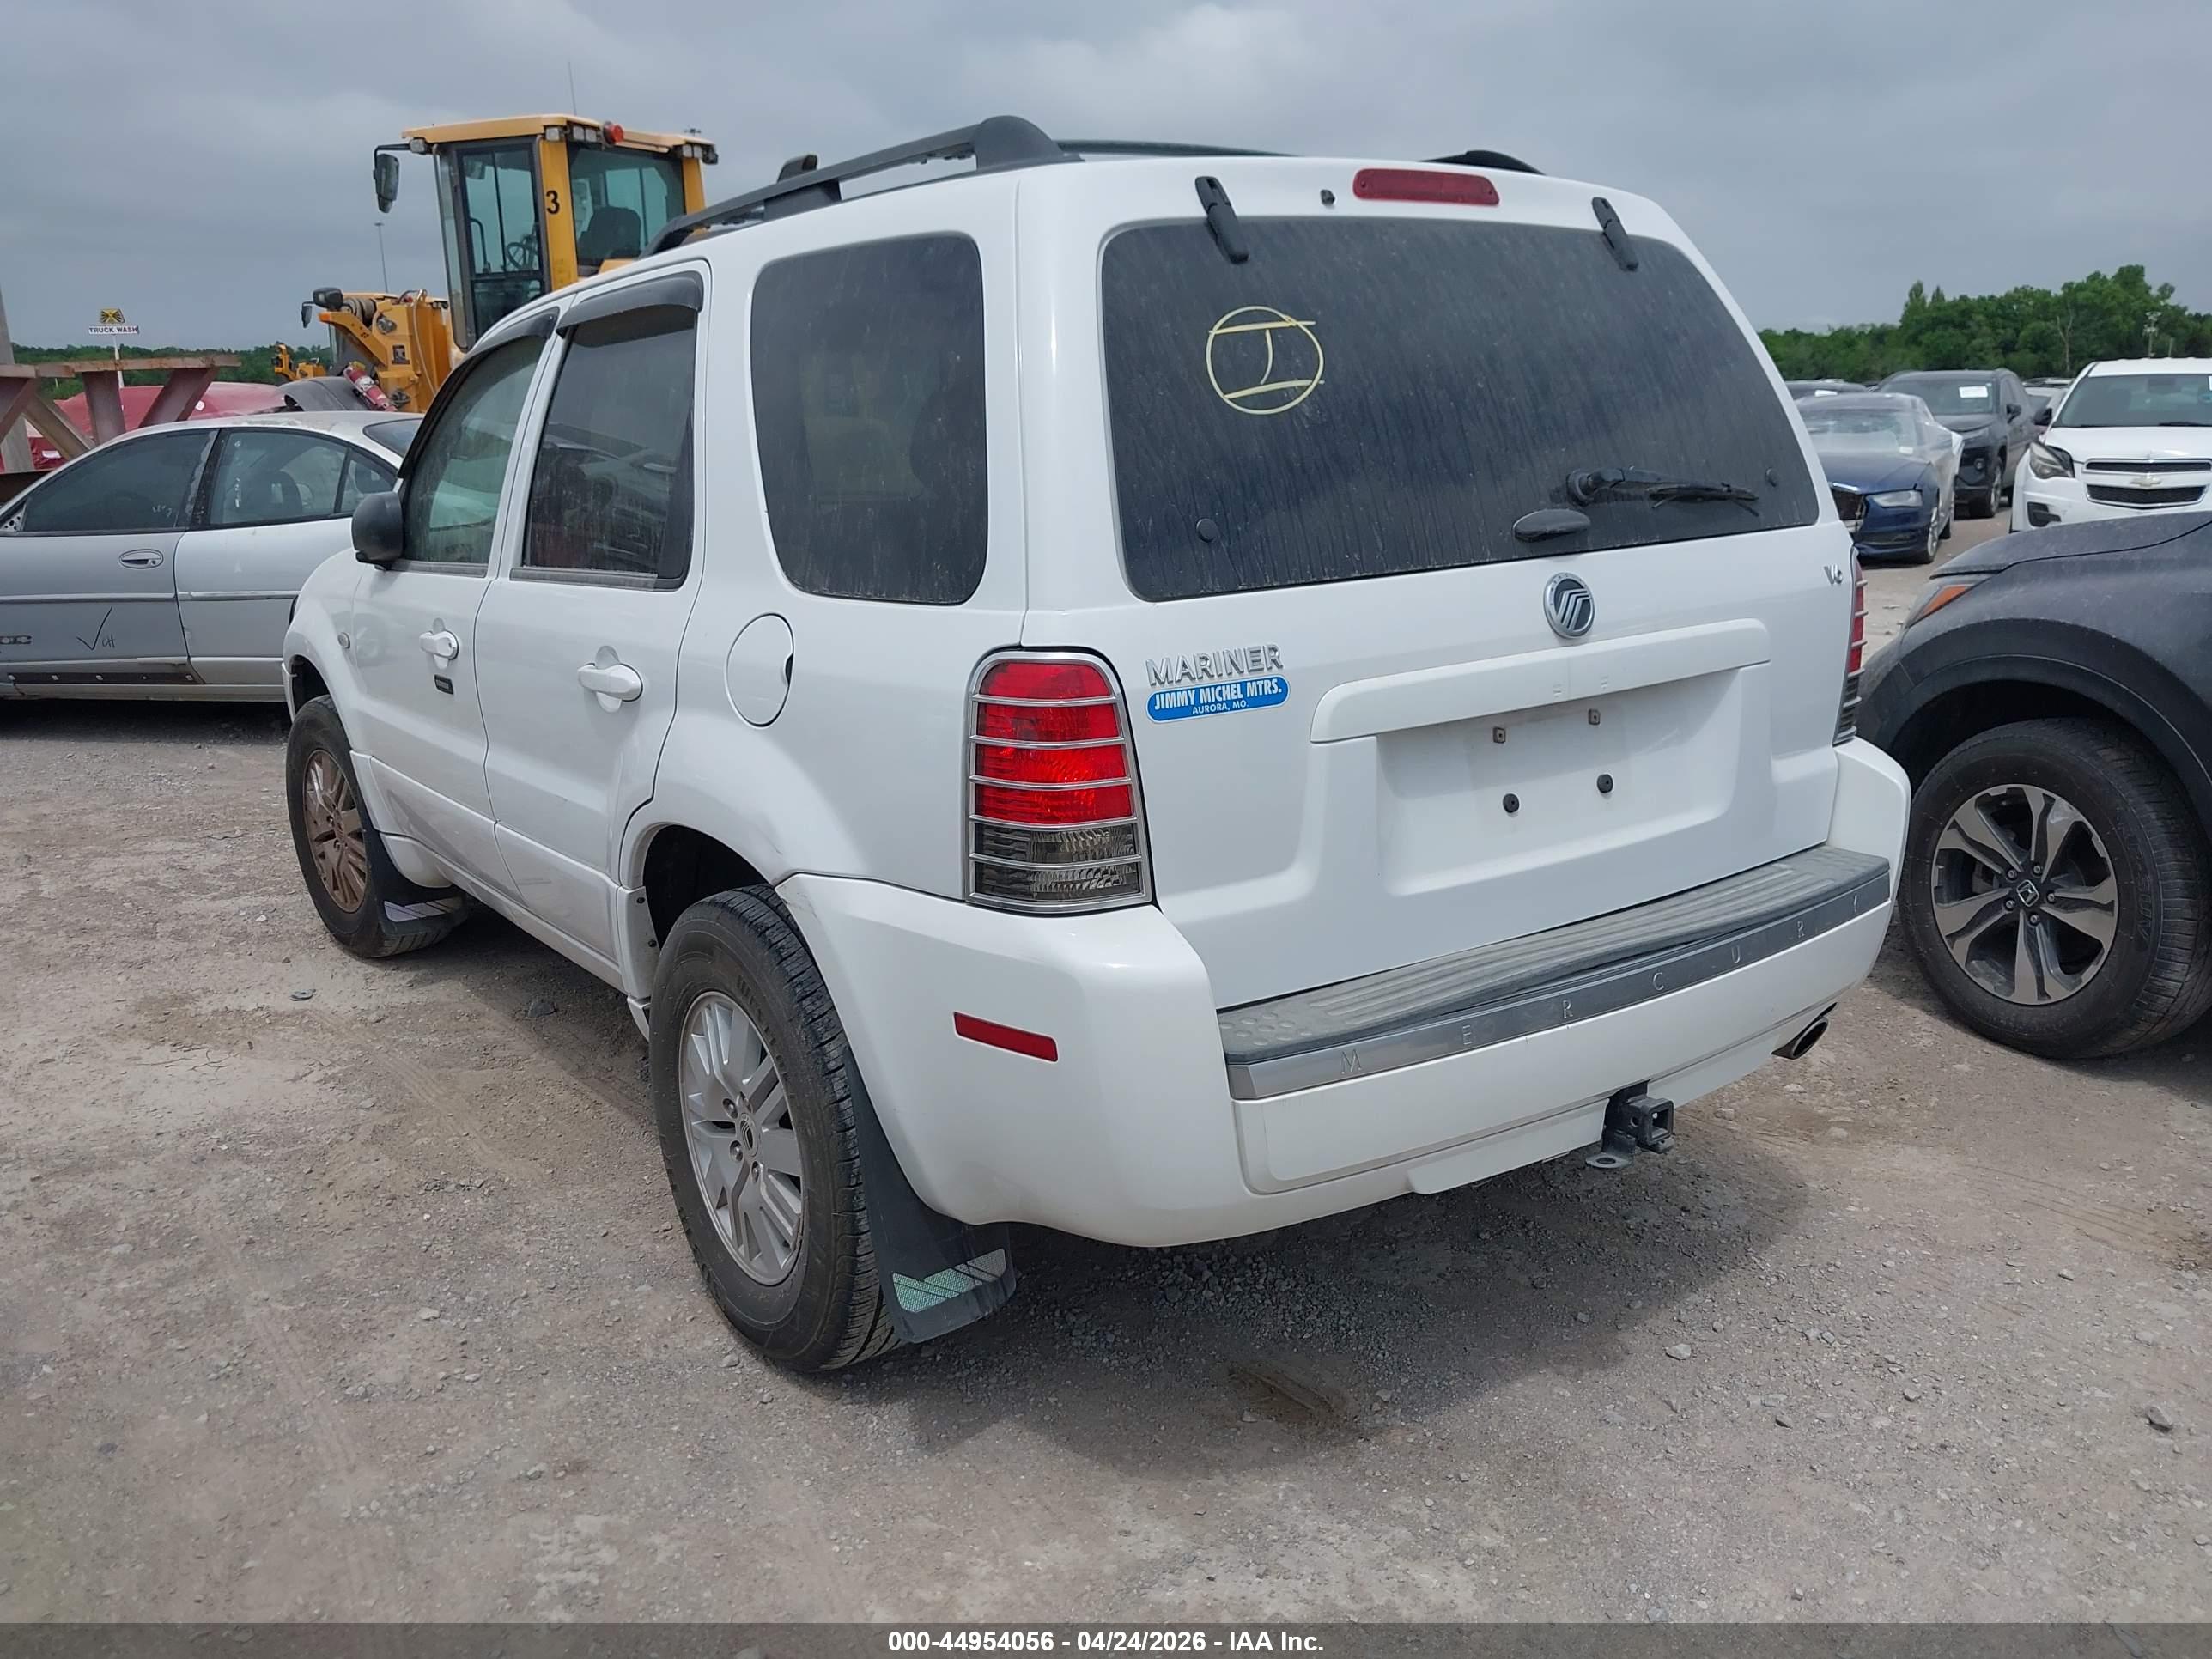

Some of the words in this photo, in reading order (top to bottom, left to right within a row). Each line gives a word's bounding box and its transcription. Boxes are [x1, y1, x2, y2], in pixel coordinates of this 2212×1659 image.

[546, 190, 560, 215] 3
[1145, 644, 1284, 686] MARINER
[1154, 689, 1196, 710] JIMMY
[1200, 684, 1243, 703] MICHEL
[1247, 678, 1282, 697] MTRS.
[1192, 703, 1231, 715] AURORA,
[1232, 700, 1249, 709] MO.
